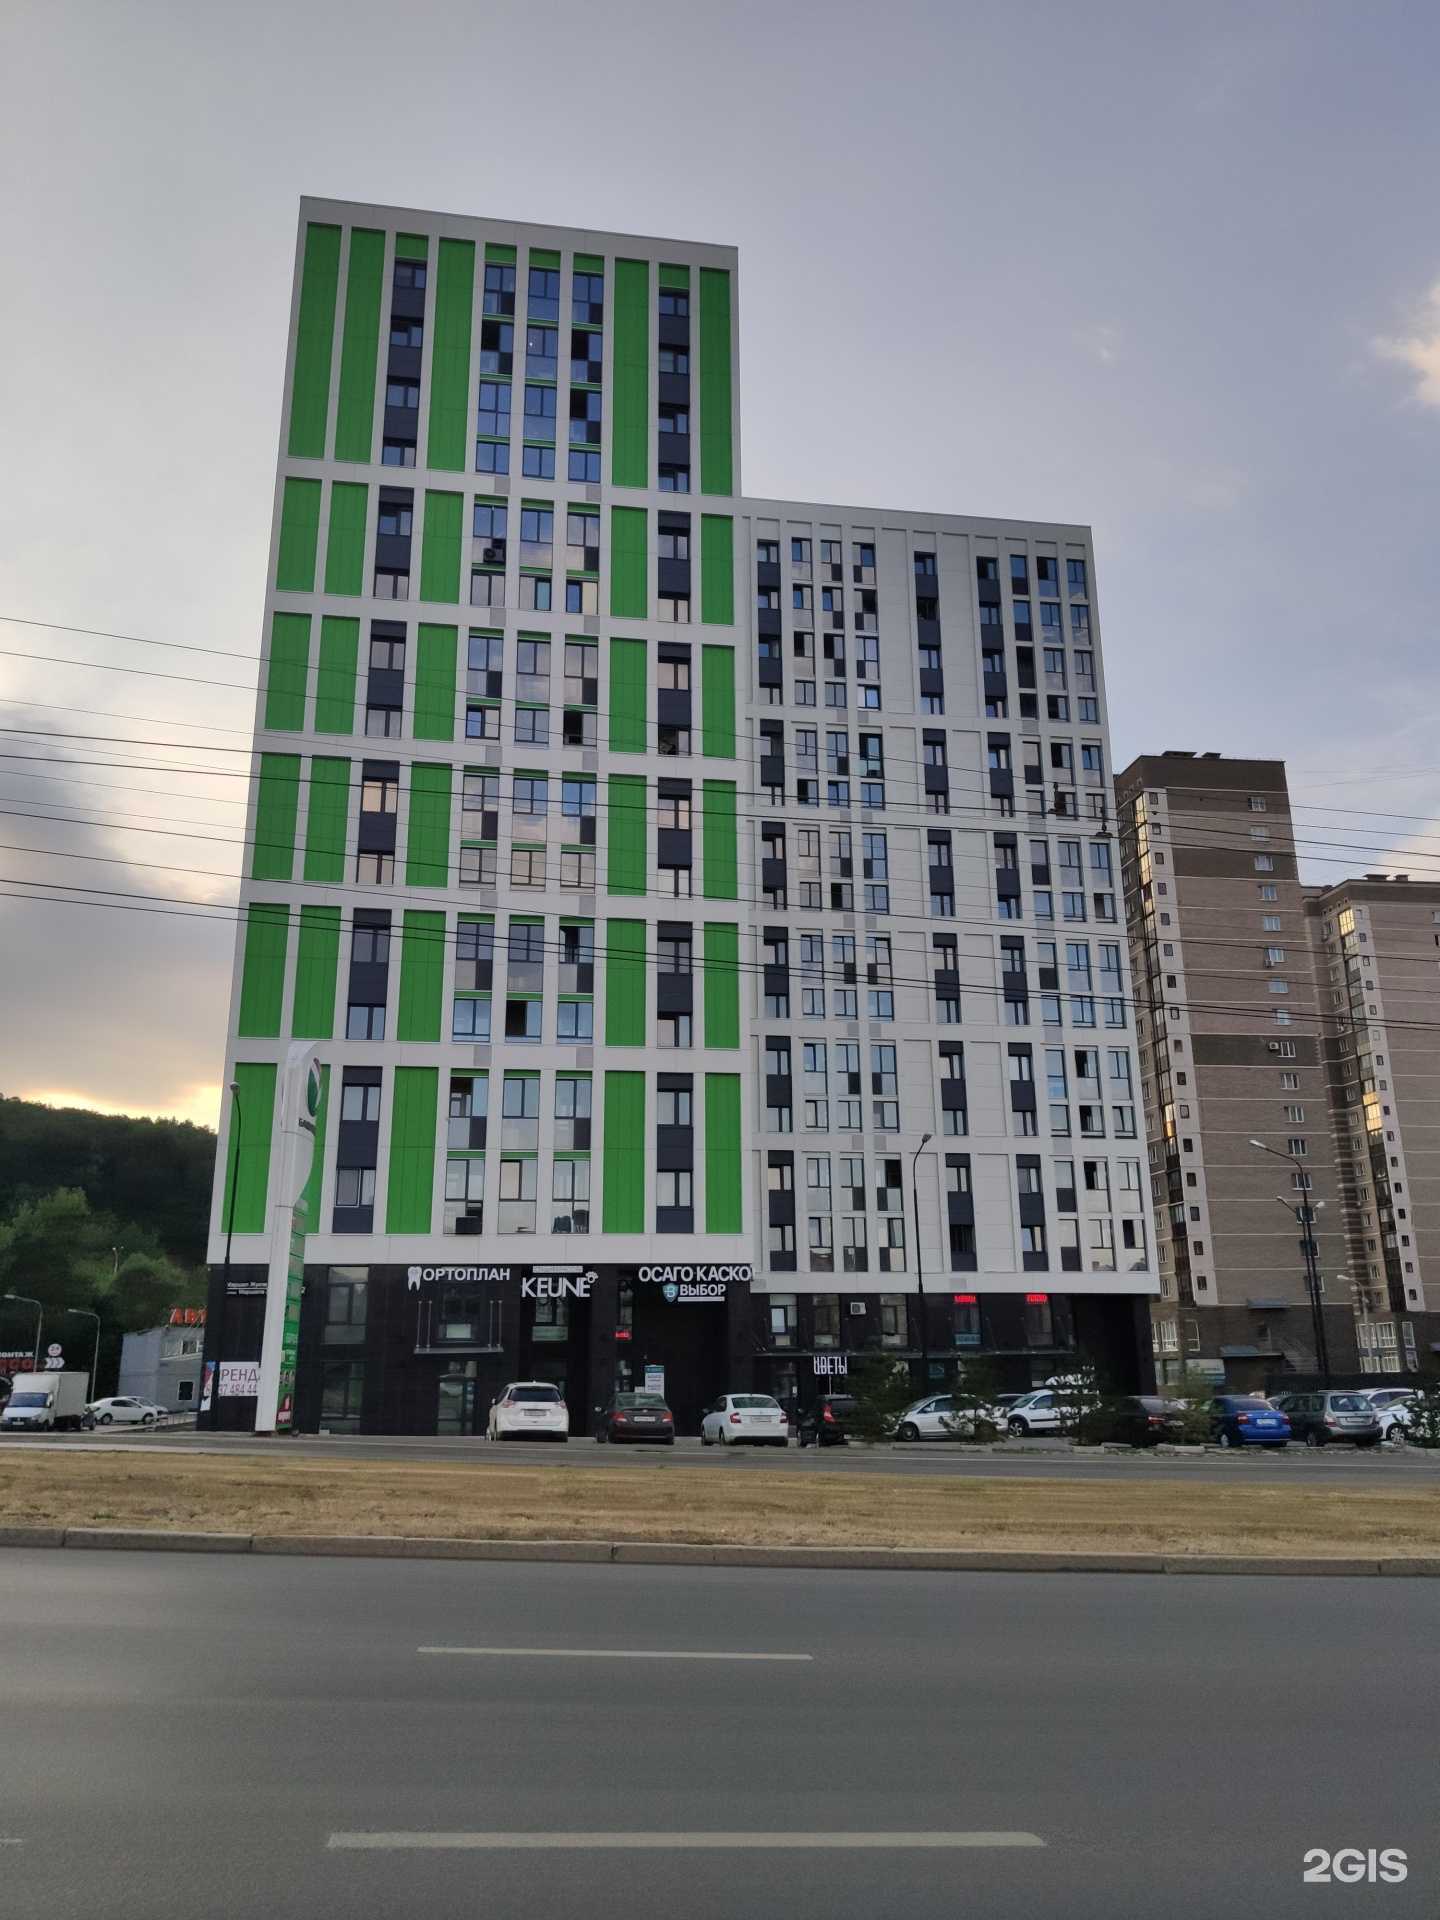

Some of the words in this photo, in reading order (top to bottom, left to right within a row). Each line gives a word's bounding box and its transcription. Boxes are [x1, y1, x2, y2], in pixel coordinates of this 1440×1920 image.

[422, 1267, 511, 1282] ОРТОПЛАН
[638, 1266, 694, 1282] ОСАГО
[696, 1266, 751, 1282] КАСКО
[521, 1277, 591, 1298] KEUNE
[679, 1284, 726, 1296] ВЫБОР
[813, 1356, 848, 1375] ЦВЕТЫ
[220, 1368, 261, 1383] РЕНД
